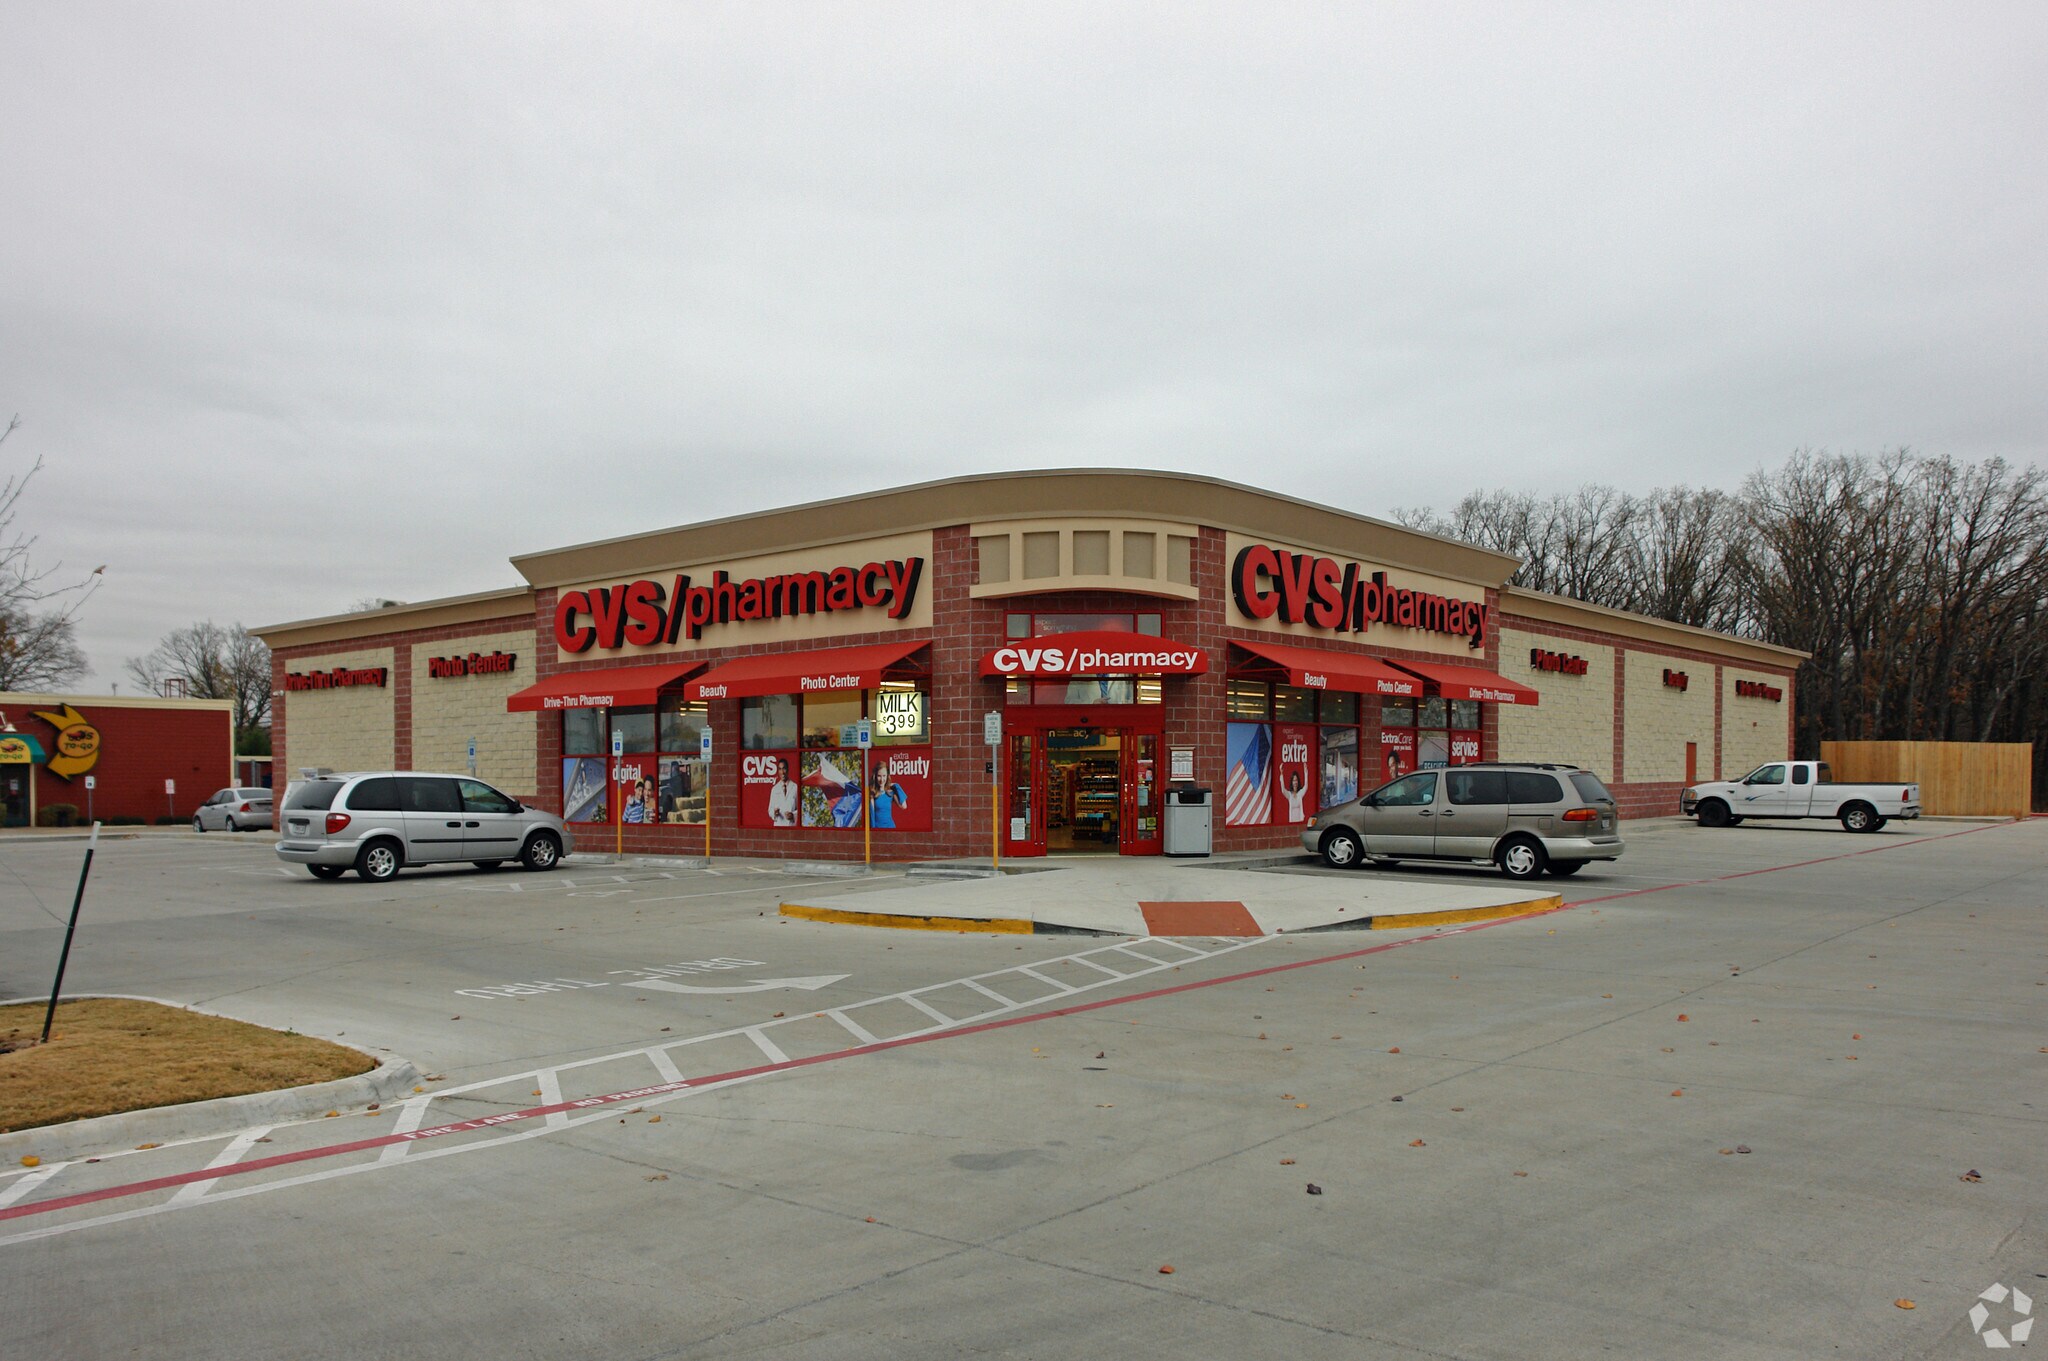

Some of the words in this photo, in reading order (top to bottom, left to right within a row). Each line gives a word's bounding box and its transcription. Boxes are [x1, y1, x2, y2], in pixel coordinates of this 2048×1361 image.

[554, 557, 924, 653] CVS/pharmacy
[1234, 544, 1489, 649] CVS/pharmacy
[429, 656, 465, 678] Photo
[467, 651, 517, 675] Center
[993, 648, 1198, 672] CVS/pharmacy
[332, 667, 387, 688] Pharmacy
[801, 676, 827, 690] Photo
[829, 674, 860, 688] Center
[1304, 672, 1327, 689] Beauty
[1377, 679, 1394, 693] Photo
[1394, 681, 1412, 695] Center
[544, 695, 578, 708] Drive-Thru
[579, 694, 614, 707] Pharmacy
[700, 684, 727, 698] Beauty
[1469, 687, 1493, 700] Drive-Thru
[1494, 690, 1516, 703] Pharmacy
[880, 693, 918, 713] MILK
[64, 742, 94, 750] TO-GO
[1282, 739, 1308, 763] extra
[1452, 737, 1478, 757] service
[612, 763, 641, 784] dgital
[743, 755, 778, 776] CVS
[889, 756, 930, 779] beauty
[744, 776, 777, 786] pharmacy
[454, 978, 610, 1000] THRU
[404, 1124, 461, 1140] FIRE
[466, 1112, 528, 1129] LANE
[574, 1098, 604, 1108] NO
[609, 1082, 690, 1101] PARKING
